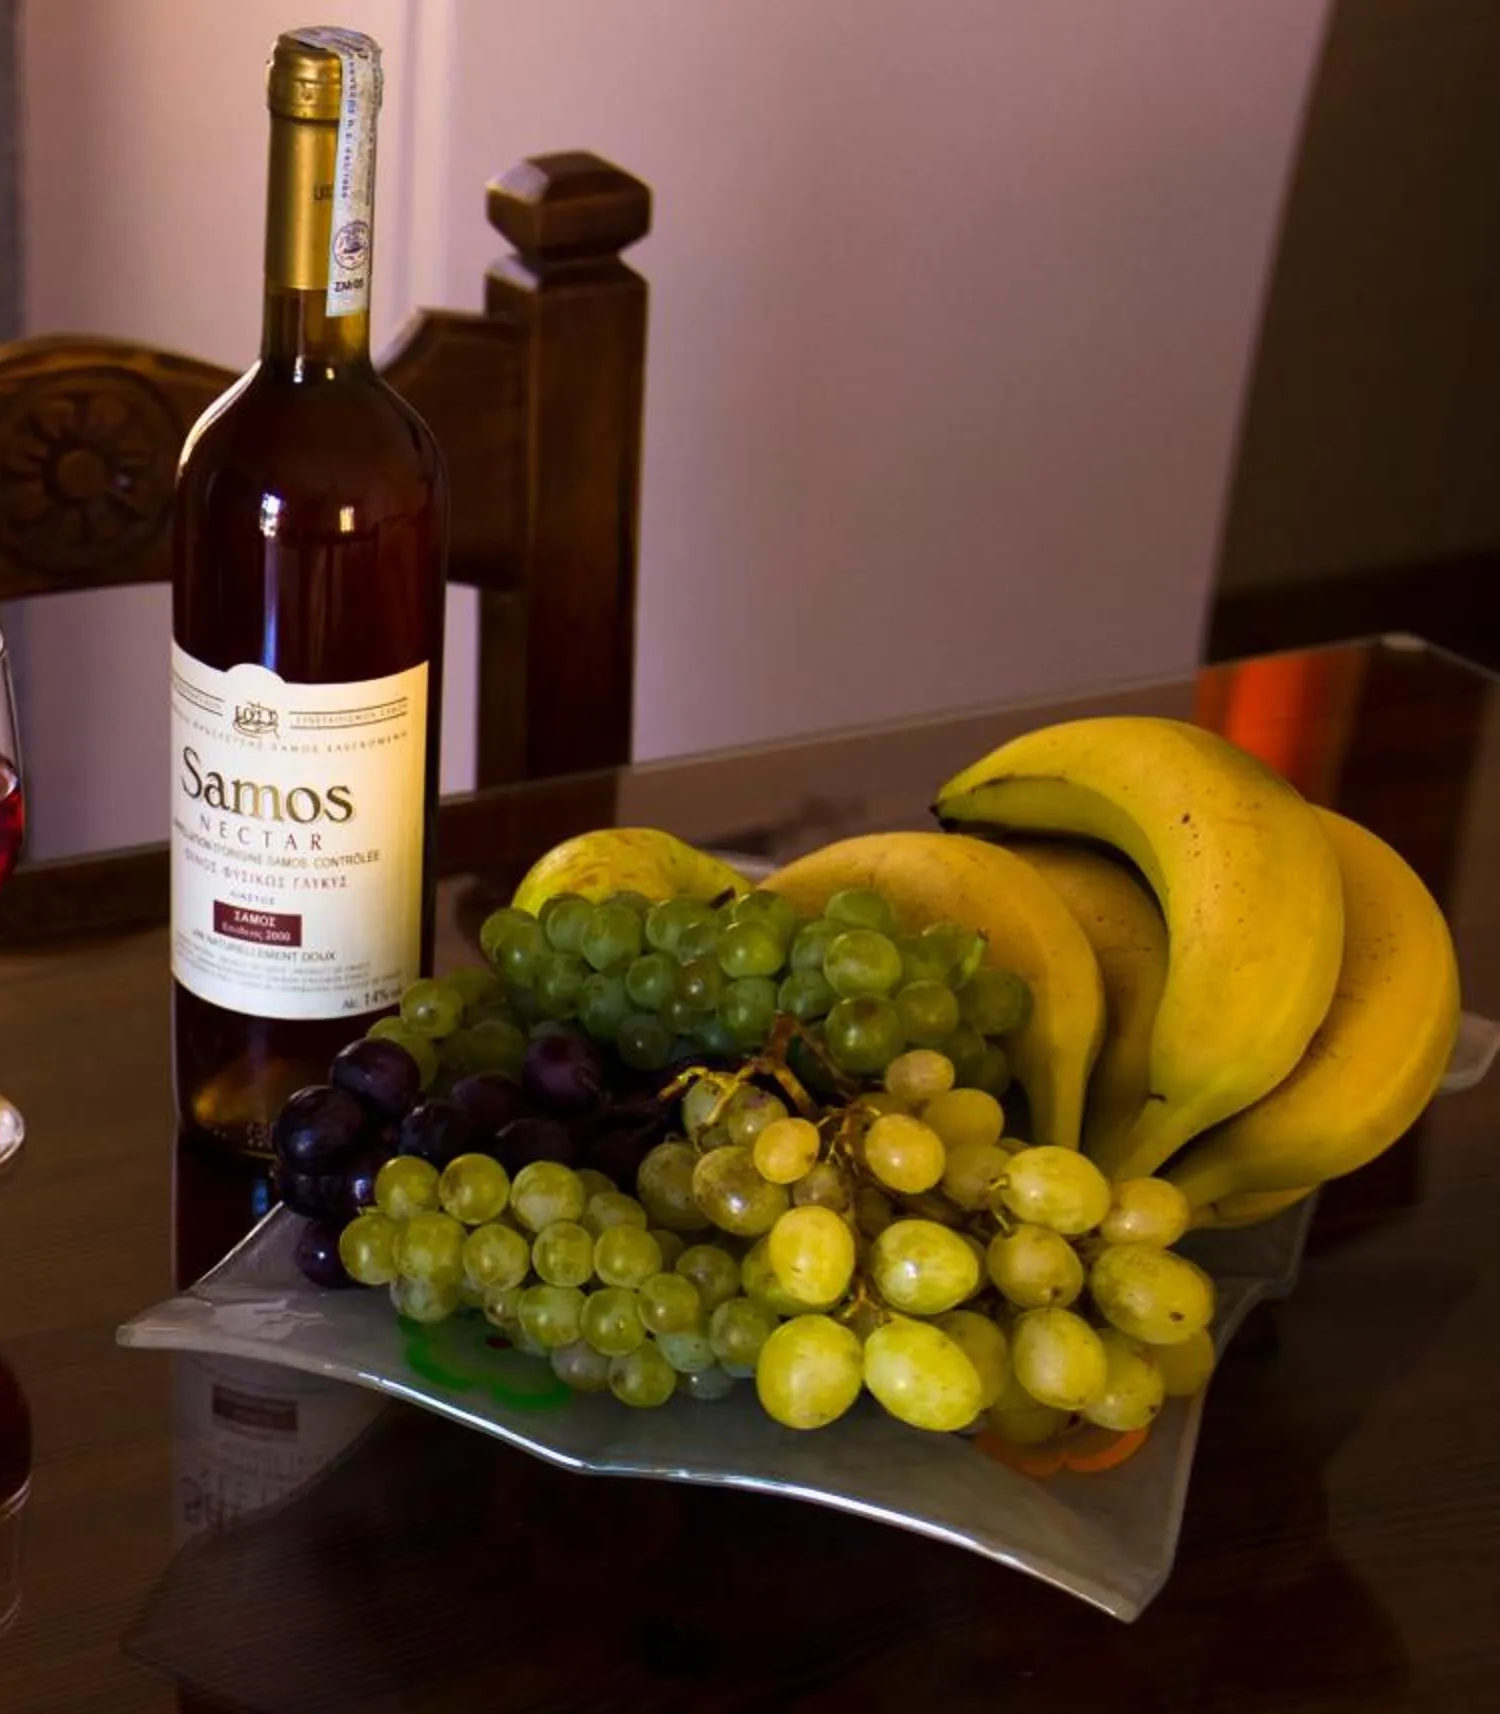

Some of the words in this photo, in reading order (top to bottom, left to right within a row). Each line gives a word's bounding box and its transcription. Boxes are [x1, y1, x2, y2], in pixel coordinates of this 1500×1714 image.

[180, 745, 353, 824] Samos
[200, 813, 323, 851] NECTAR
[266, 854, 308, 869] SAMOS
[234, 910, 276, 928] ΣΑΜΟΣ
[302, 949, 338, 961] DOUX
